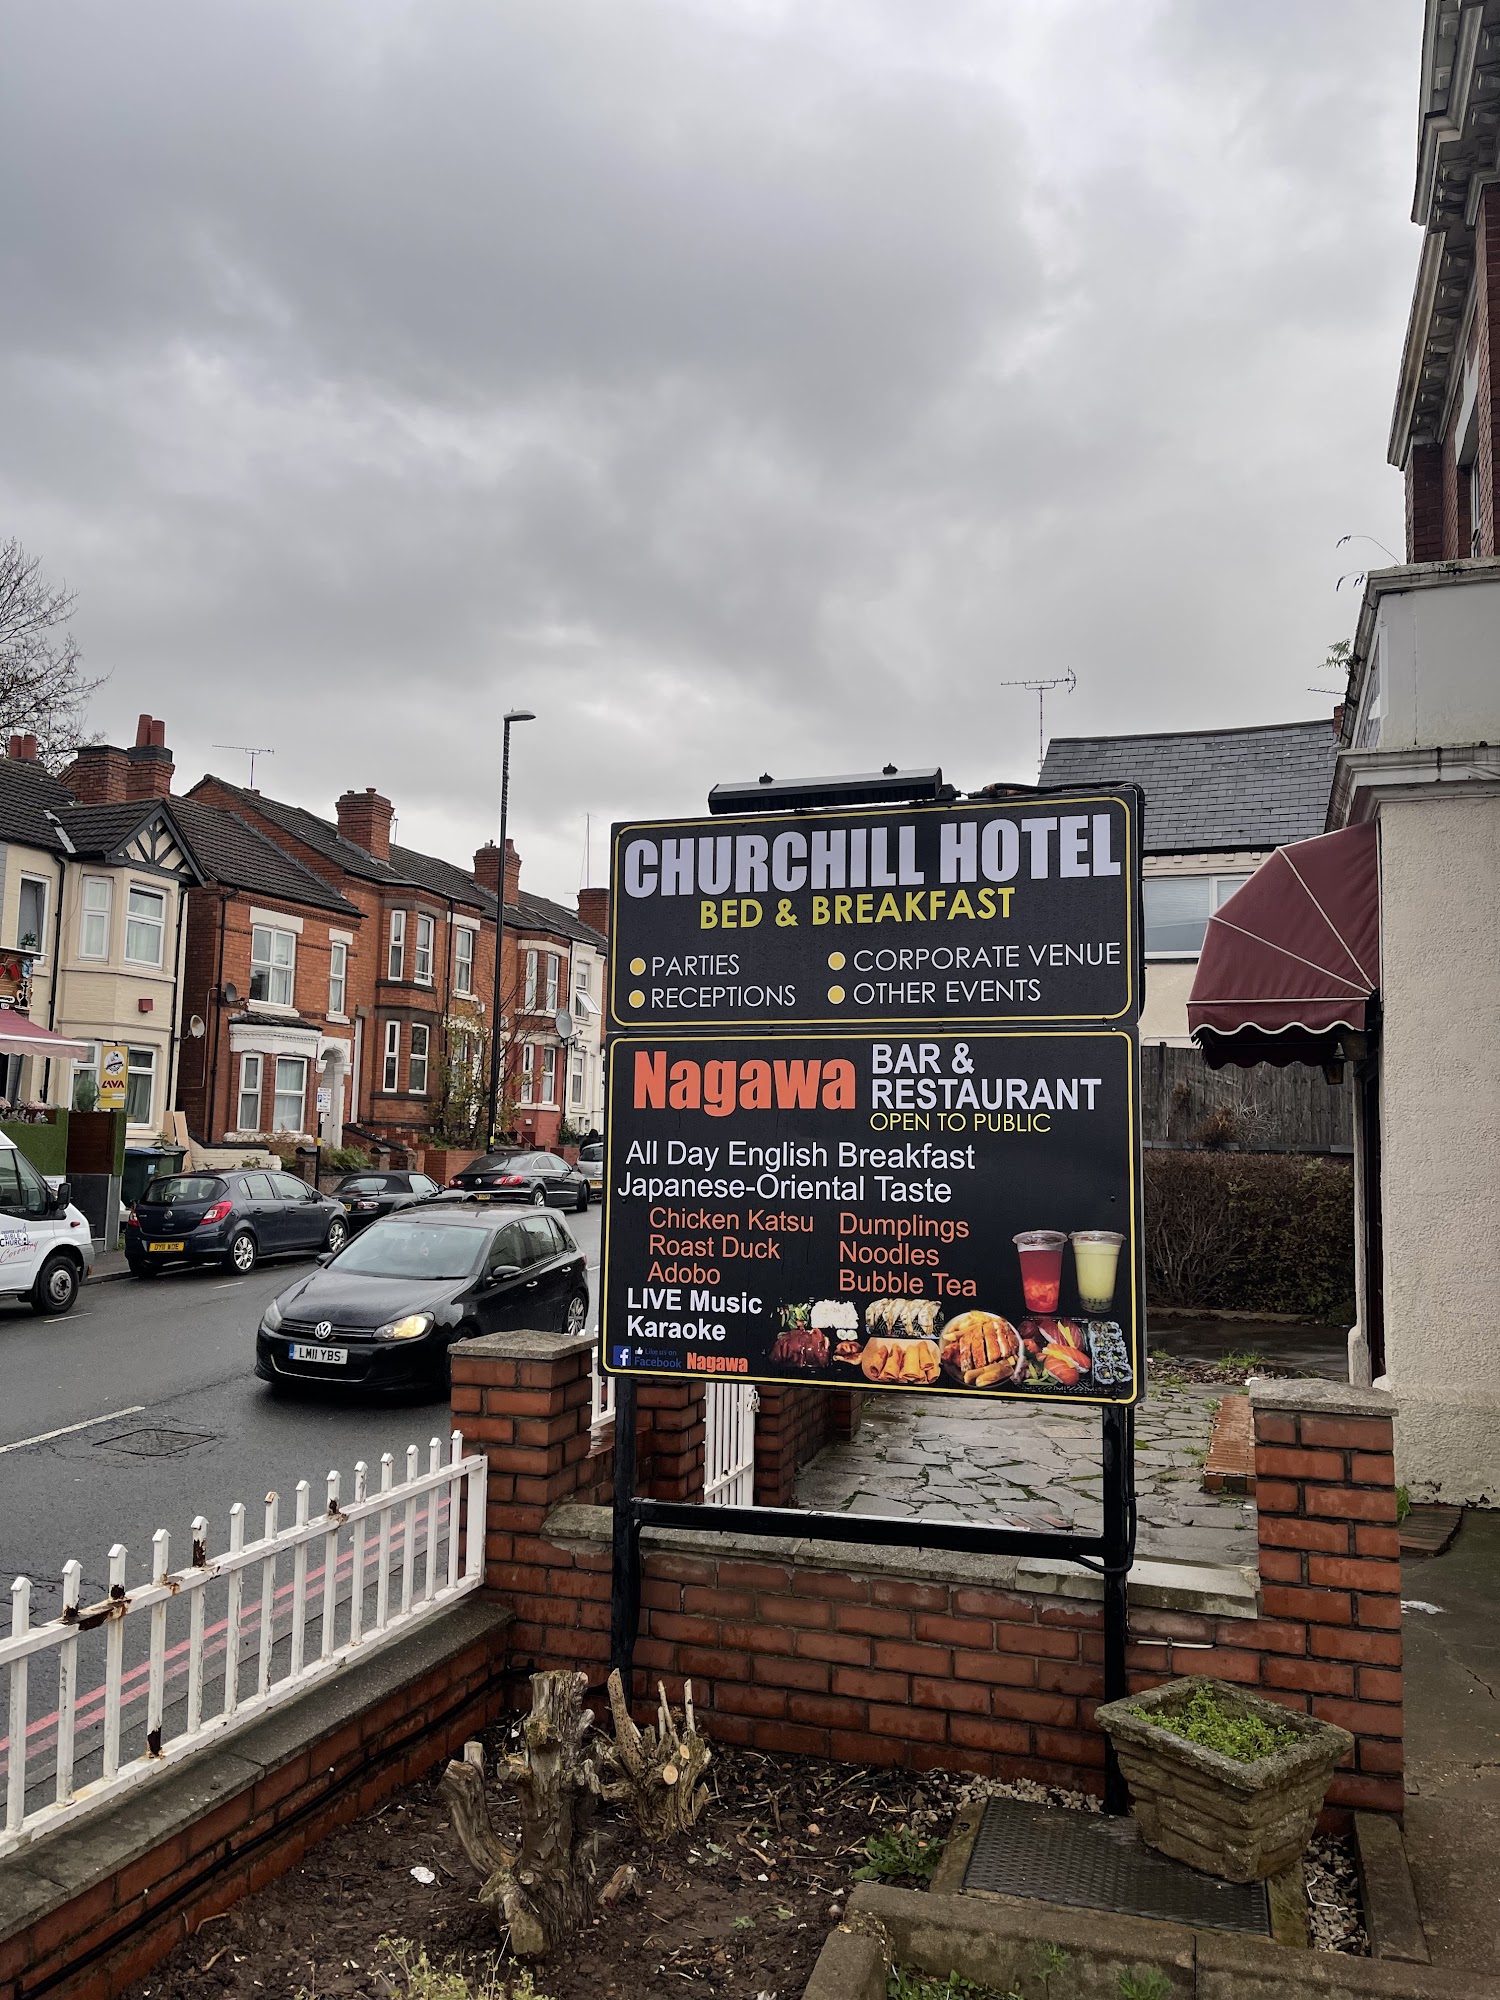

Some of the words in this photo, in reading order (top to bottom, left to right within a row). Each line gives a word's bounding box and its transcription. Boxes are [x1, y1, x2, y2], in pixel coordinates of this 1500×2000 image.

[625, 826, 924, 898] CHURCHILL
[940, 814, 1121, 883] HOTEL
[701, 899, 762, 929] BED
[776, 899, 798, 927] &
[813, 887, 1015, 925] BREAKFAST
[652, 954, 739, 976] PARTIES
[854, 946, 1019, 971] CORPORATE
[1028, 943, 1120, 966] VENUE
[652, 985, 795, 1008] RECEPTIONS
[854, 982, 935, 1004] OTHER
[947, 979, 1040, 1002] EVENTS
[873, 1044, 941, 1074] BAR
[952, 1043, 974, 1074] &
[102, 1080, 124, 1088] LAVA
[634, 1051, 855, 1116] Nagawa
[872, 1079, 1101, 1110] RESTAURANT
[870, 1113, 929, 1130] OPEN
[937, 1113, 966, 1131] TO
[975, 1114, 1050, 1132] PUBLIC
[626, 1141, 657, 1164] All
[668, 1141, 719, 1171] Day
[729, 1141, 827, 1172] English
[839, 1142, 975, 1169] Breakfast
[618, 1172, 864, 1202] Japanese-Oriental
[874, 1176, 951, 1203] Taste
[650, 1207, 739, 1229] Chicken
[749, 1210, 813, 1232] Katsu
[840, 1213, 969, 1240] Dumplings
[650, 1235, 714, 1257] Roast
[723, 1237, 780, 1259] Duck
[840, 1241, 939, 1265] Noodles
[648, 1262, 720, 1284] Adobo
[840, 1269, 923, 1294] Bubble
[932, 1273, 976, 1296] Tea
[628, 1288, 681, 1310] LIVE
[690, 1290, 762, 1314] Music
[628, 1315, 725, 1340] Karaoke
[320, 1350, 341, 1361] YBS
[634, 1357, 682, 1369] Facebook
[687, 1352, 748, 1373] Nagawa
